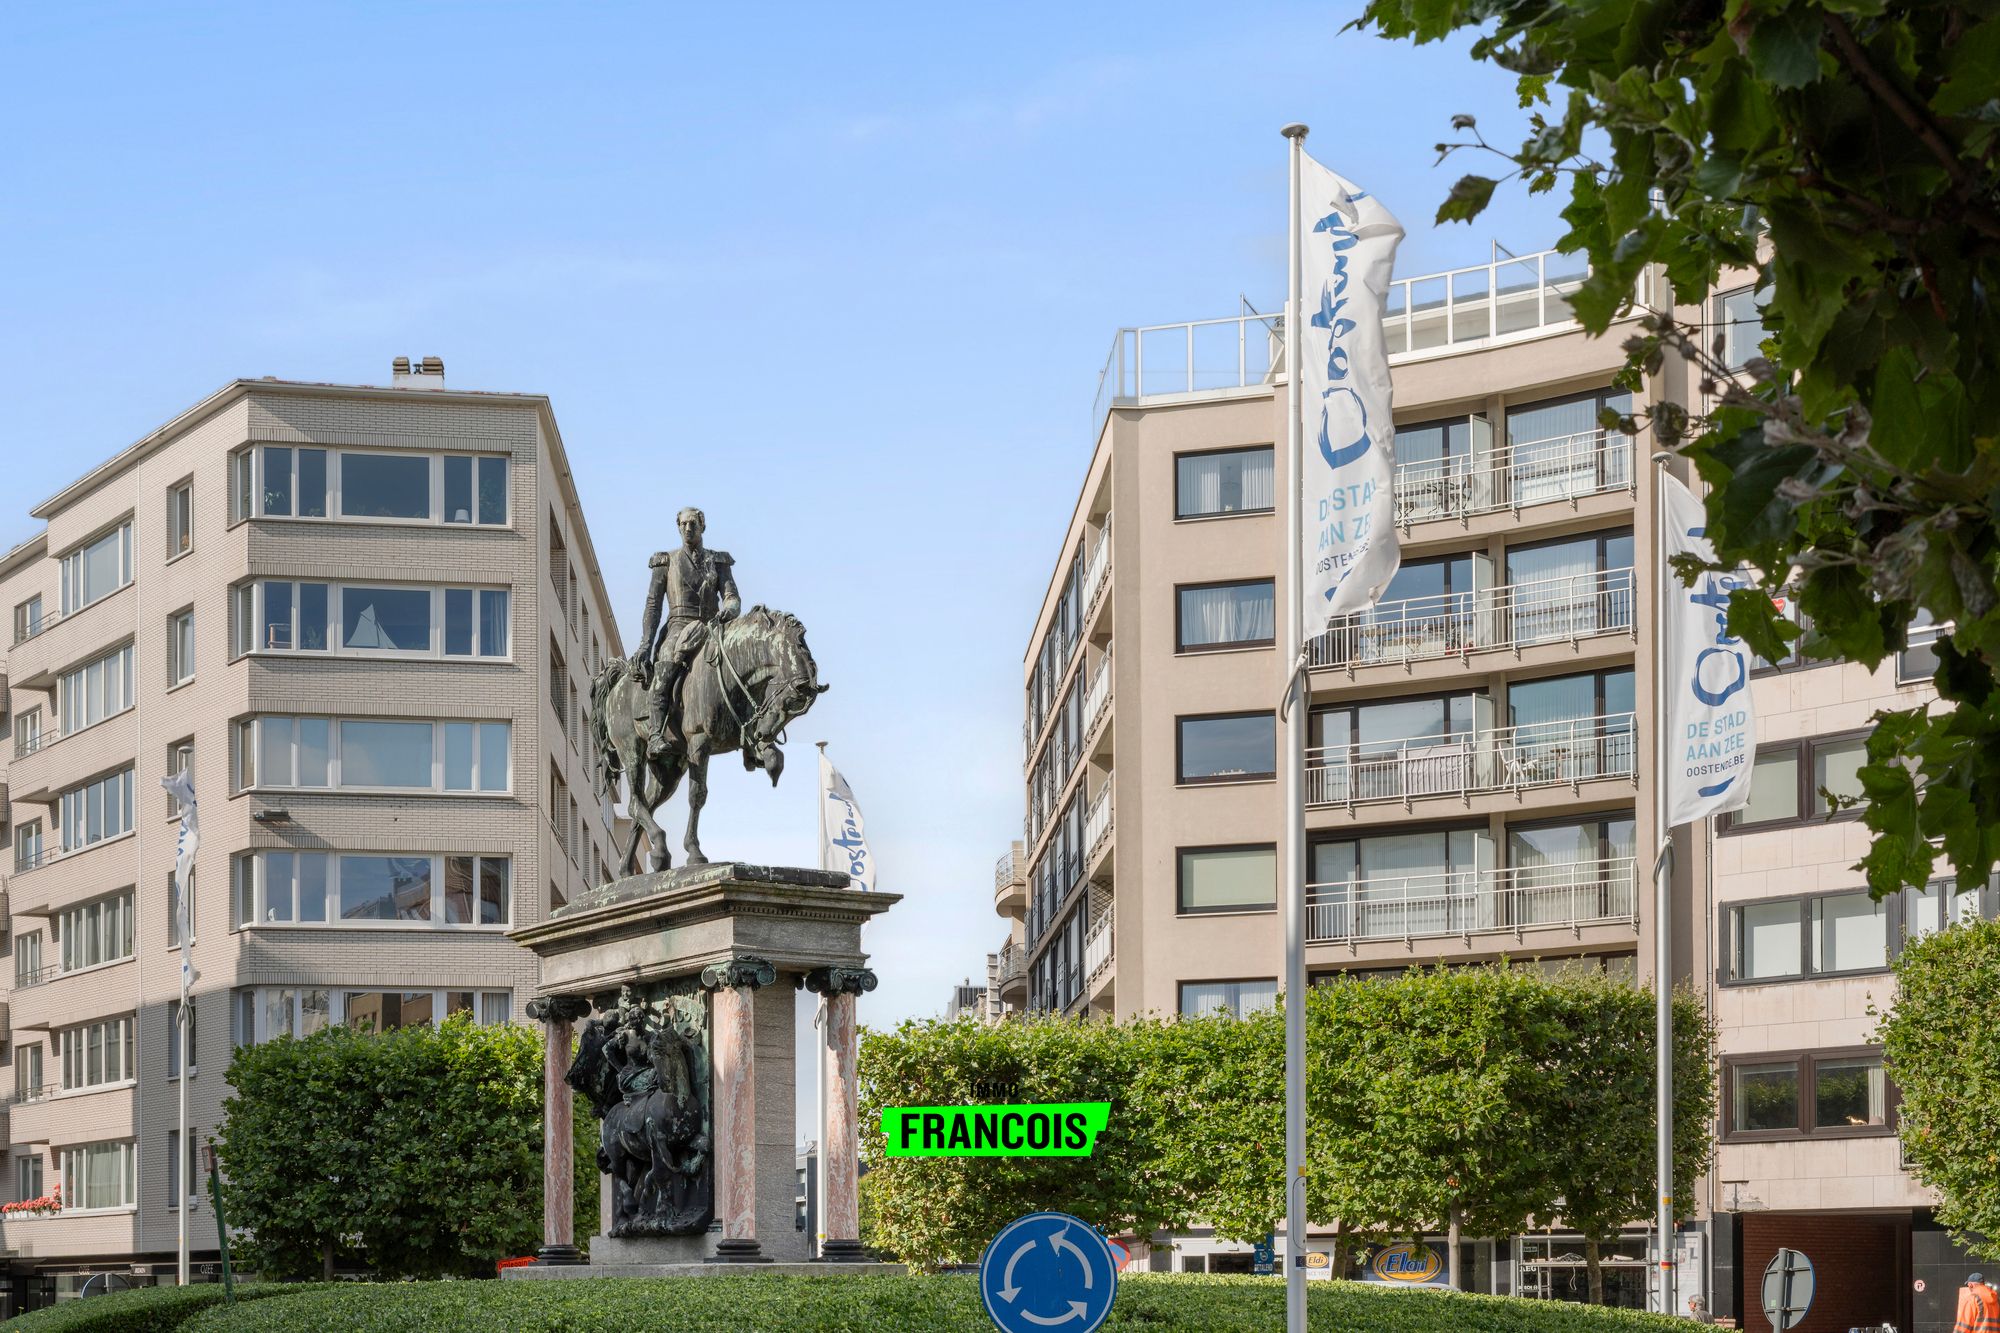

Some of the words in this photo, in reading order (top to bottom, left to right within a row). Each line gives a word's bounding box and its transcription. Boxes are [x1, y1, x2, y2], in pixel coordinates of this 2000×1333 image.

[1332, 478, 1377, 511] STA
[1687, 722, 1709, 739] DE
[1714, 711, 1746, 735] STAD
[1687, 742, 1721, 761] AAN
[1724, 732, 1745, 754] ZEE
[1308, 1256, 1324, 1264] Eldi
